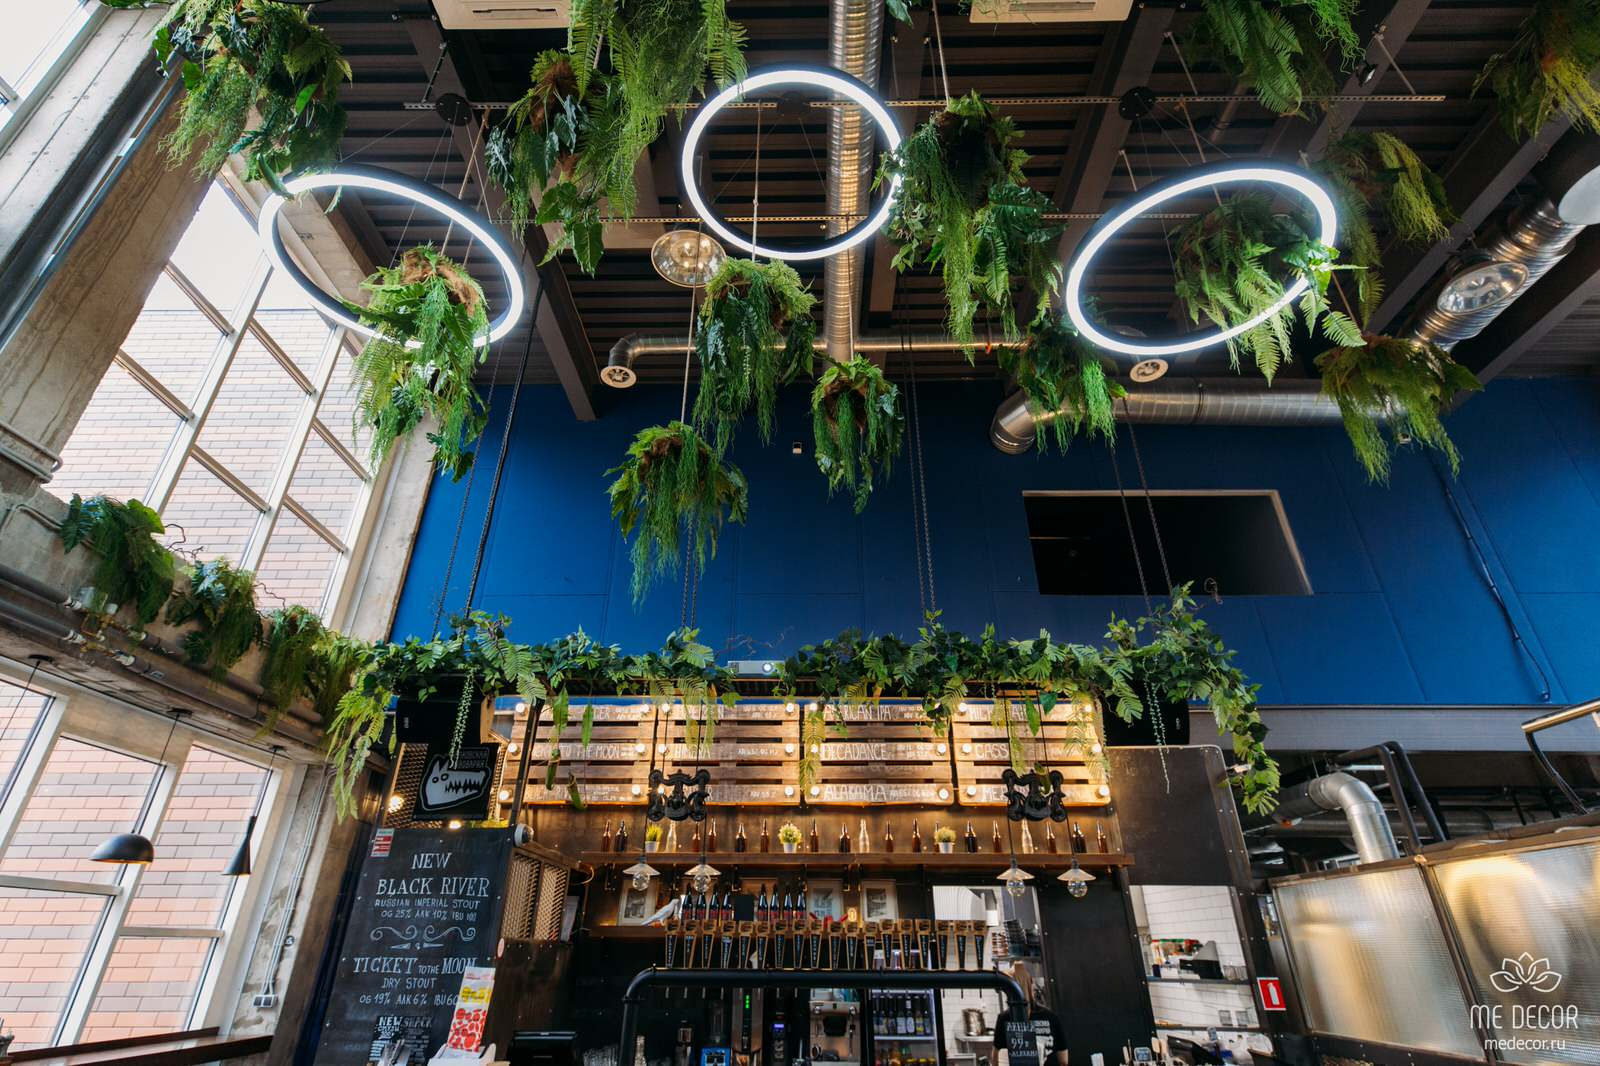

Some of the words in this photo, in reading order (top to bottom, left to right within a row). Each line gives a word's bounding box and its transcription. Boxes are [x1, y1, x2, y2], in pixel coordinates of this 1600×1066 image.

[411, 853, 452, 869] NEW
[376, 877, 433, 895] BLACK
[440, 877, 490, 897] RIVER
[374, 898, 411, 908] RUSSIAN
[414, 898, 449, 908] IMPERIAL
[452, 898, 481, 910] STOUT
[380, 910, 393, 918] OG
[394, 909, 412, 919] 25%
[452, 911, 464, 921] IBU
[352, 956, 418, 974] TICKET
[382, 977, 401, 989] DRY
[405, 977, 437, 989] STOUT
[374, 991, 391, 1005] 19%
[378, 1016, 403, 1027] NEW
